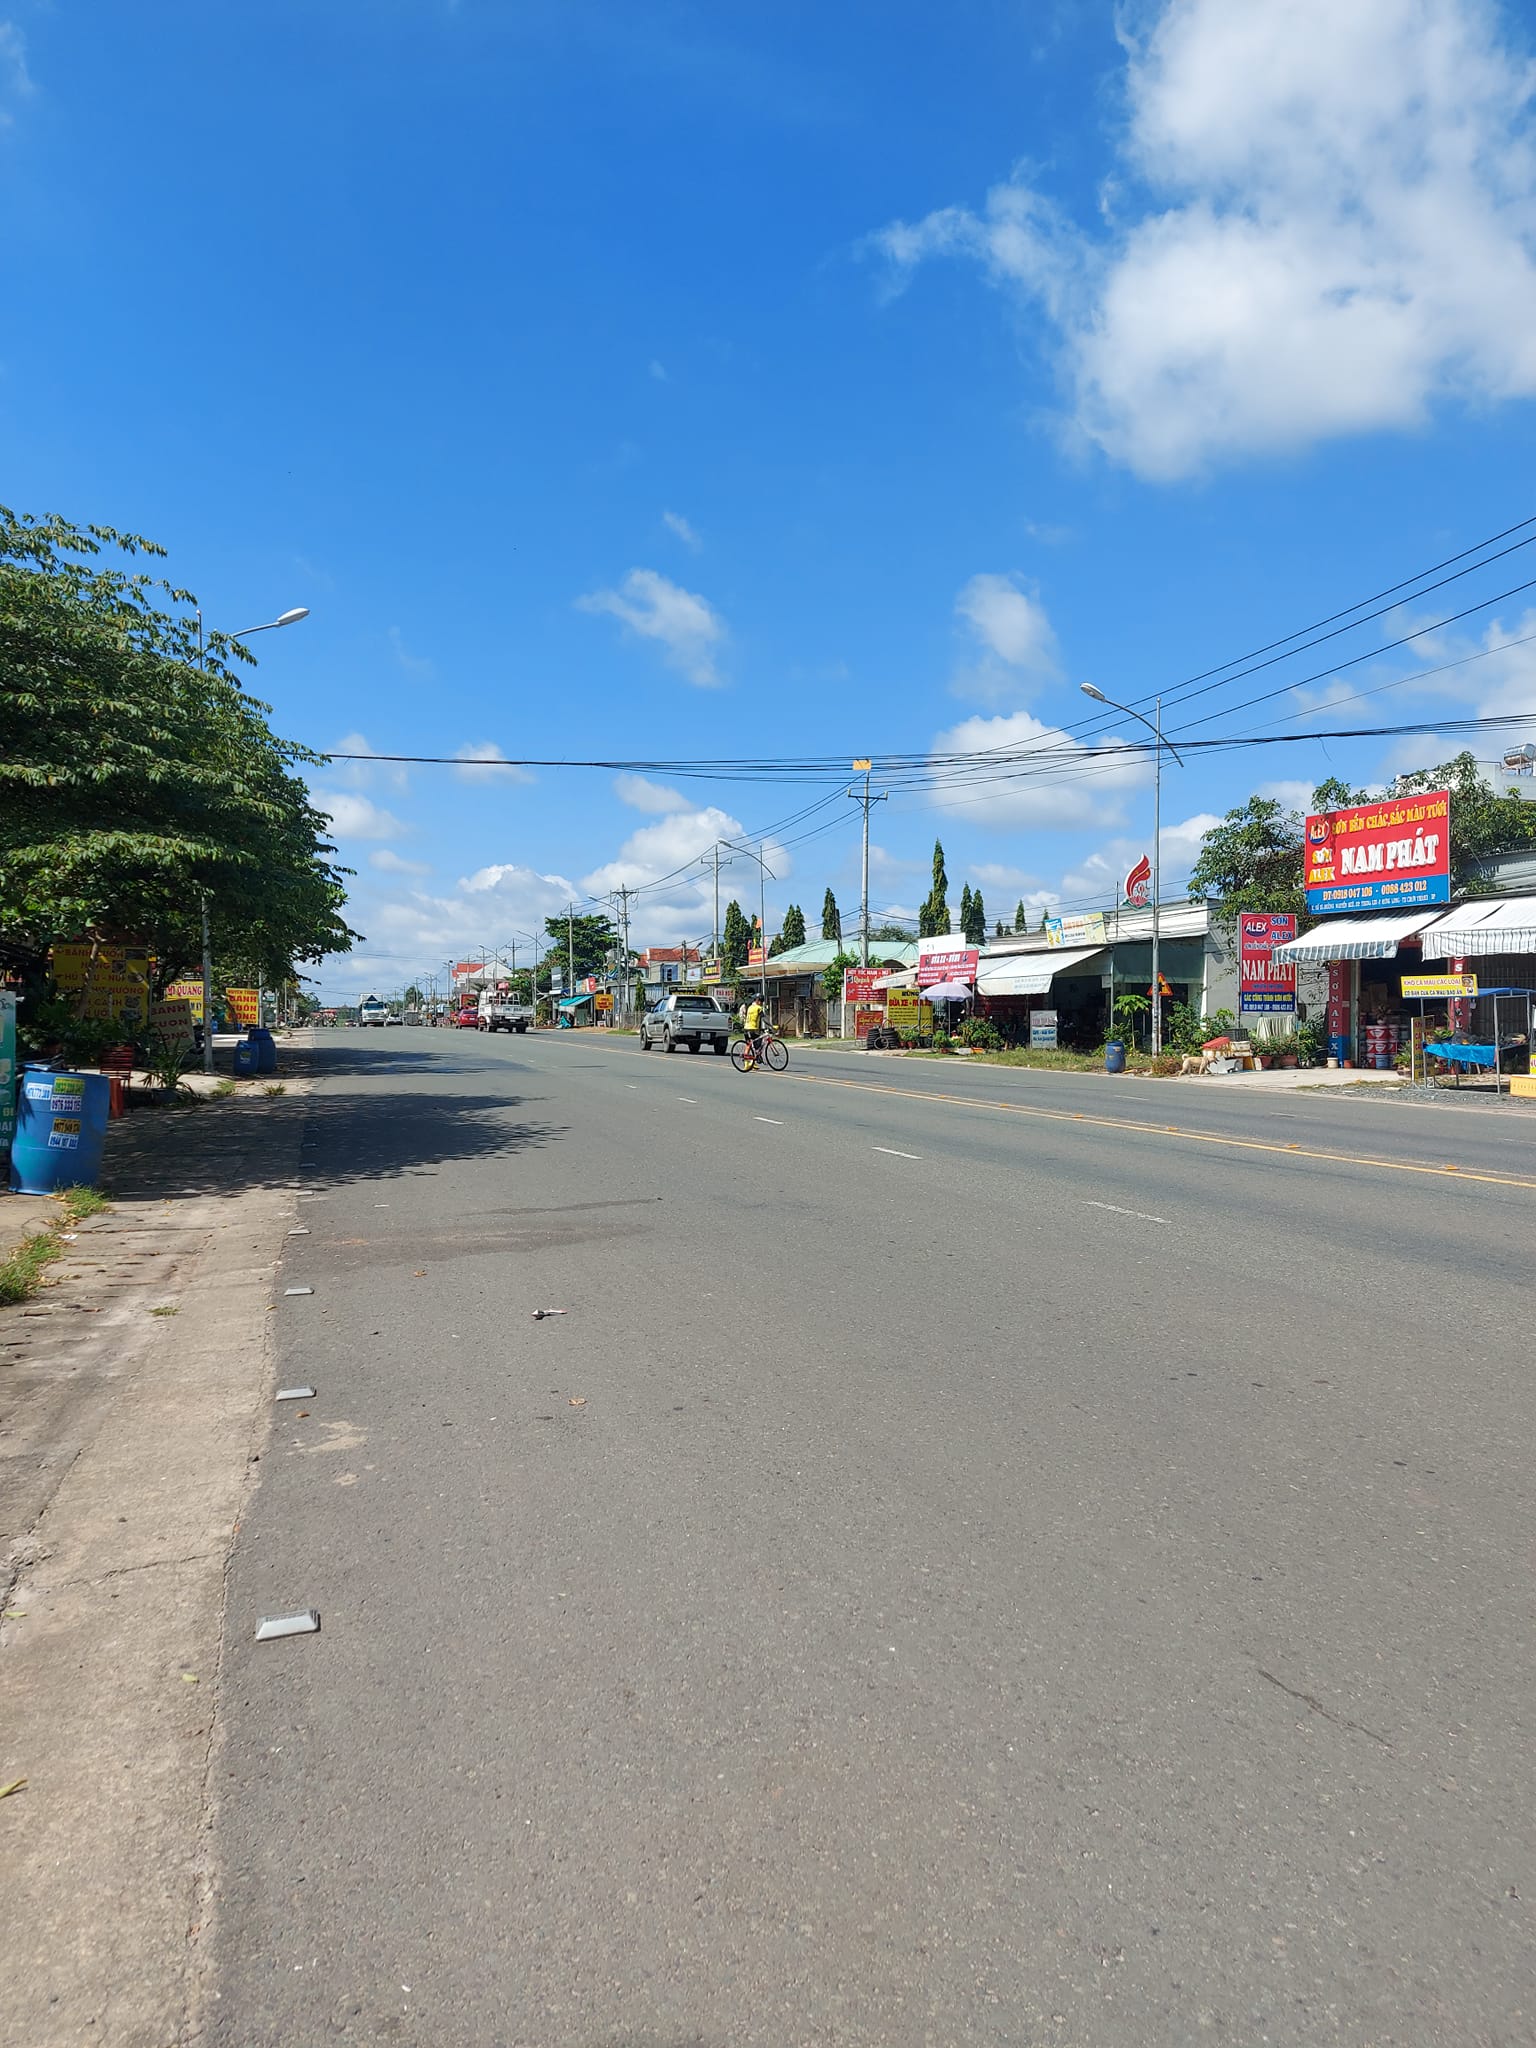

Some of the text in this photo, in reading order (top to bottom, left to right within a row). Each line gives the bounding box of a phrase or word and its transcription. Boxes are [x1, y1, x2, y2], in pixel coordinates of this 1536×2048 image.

[1311, 846, 1333, 865] SƠN
[1341, 826, 1440, 876] NAM PHÁT
[1308, 866, 1336, 884] ALEX
[1399, 880, 1414, 893] 423
[1414, 879, 1428, 892] 012
[1246, 916, 1288, 932] ALEX SƠN
[1271, 931, 1293, 940] ALEX
[1243, 960, 1265, 980] NAM
